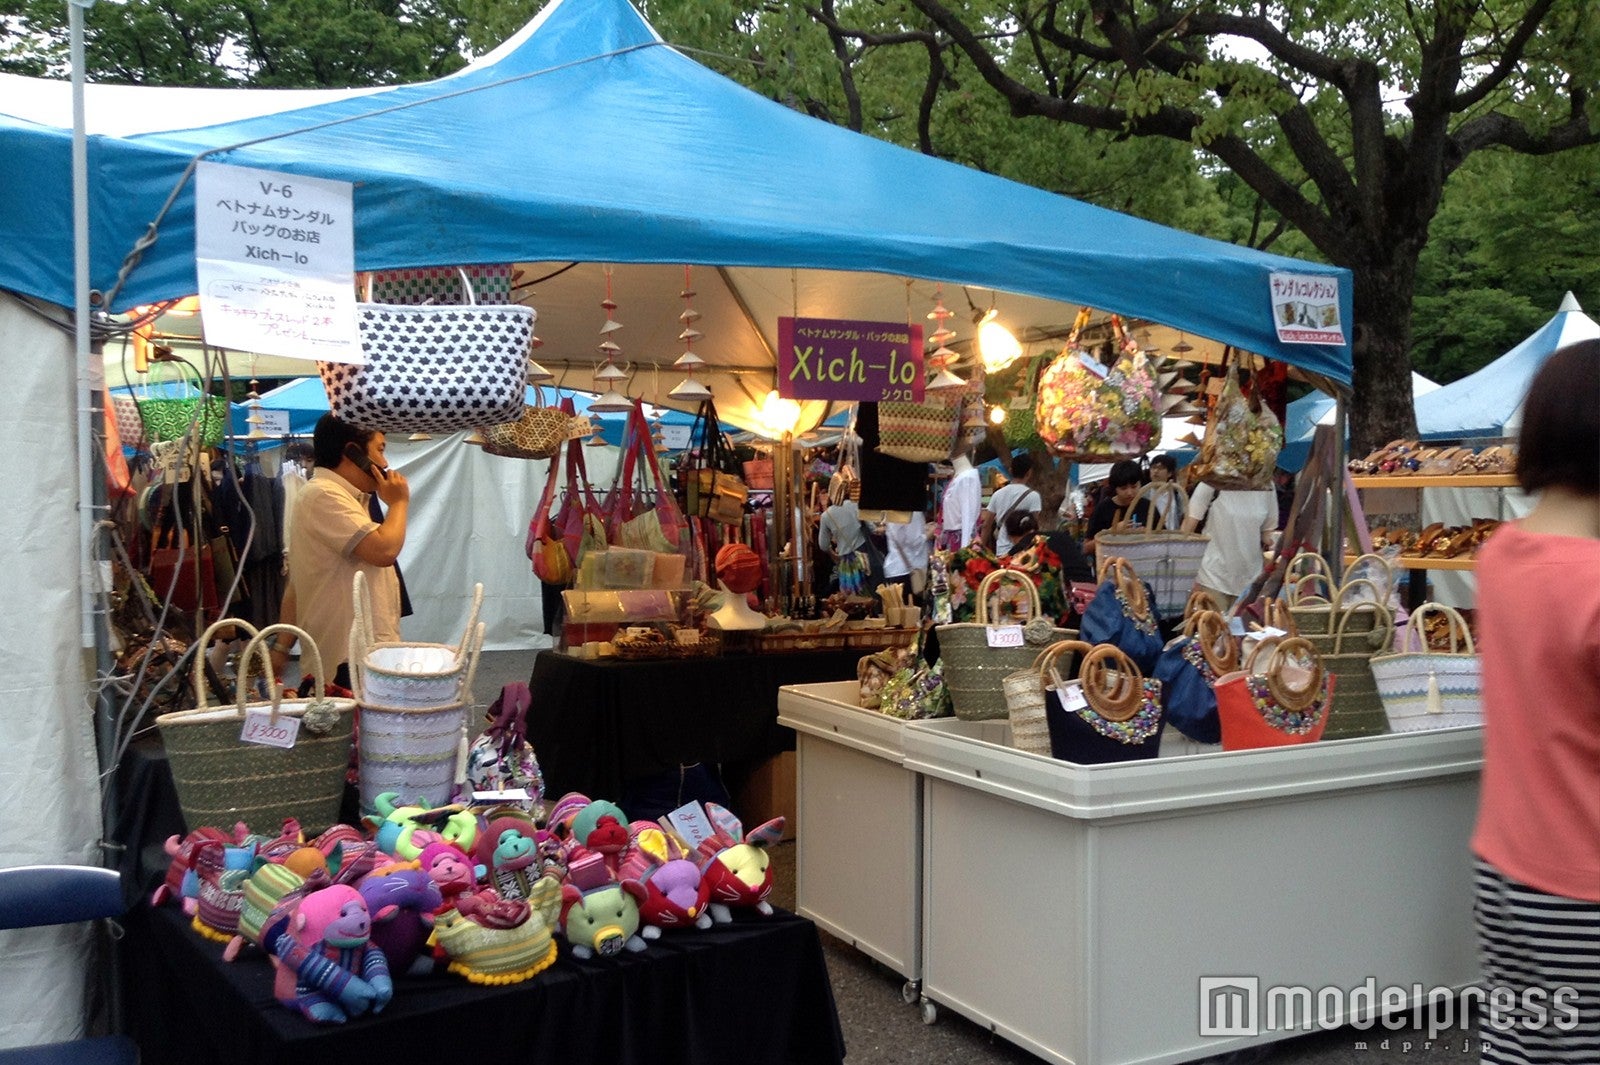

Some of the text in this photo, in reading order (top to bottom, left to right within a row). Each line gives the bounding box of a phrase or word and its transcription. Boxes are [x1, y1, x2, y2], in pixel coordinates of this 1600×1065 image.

[259, 181, 293, 199] V-6
[216, 199, 335, 226] ベトナムサンダル
[232, 220, 321, 244] バッグのお店
[881, 388, 913, 401] シクロ
